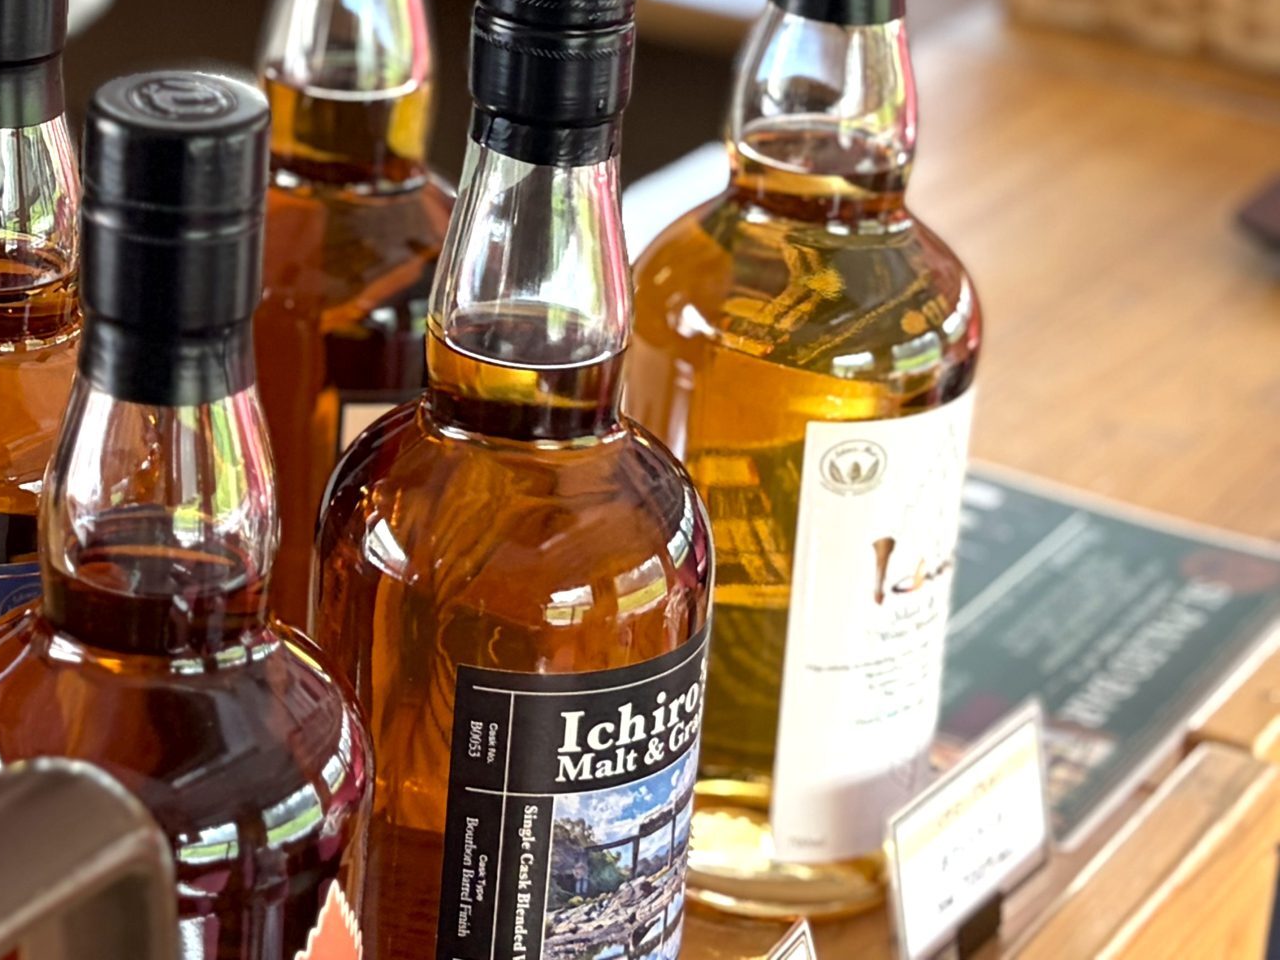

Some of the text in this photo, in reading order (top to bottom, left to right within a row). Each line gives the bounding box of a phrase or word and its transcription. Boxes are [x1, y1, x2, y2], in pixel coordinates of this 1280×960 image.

[557, 657, 707, 754] Ichiro
[468, 720, 484, 757] B0053
[488, 722, 499, 746] Cask
[554, 747, 638, 783] Malt
[643, 737, 665, 765] &
[518, 804, 539, 851] Single
[457, 816, 480, 937] Bourbon Barrel Finish
[475, 854, 489, 902] Cask Type
[518, 852, 535, 890] Cask
[512, 892, 532, 952] Blended
